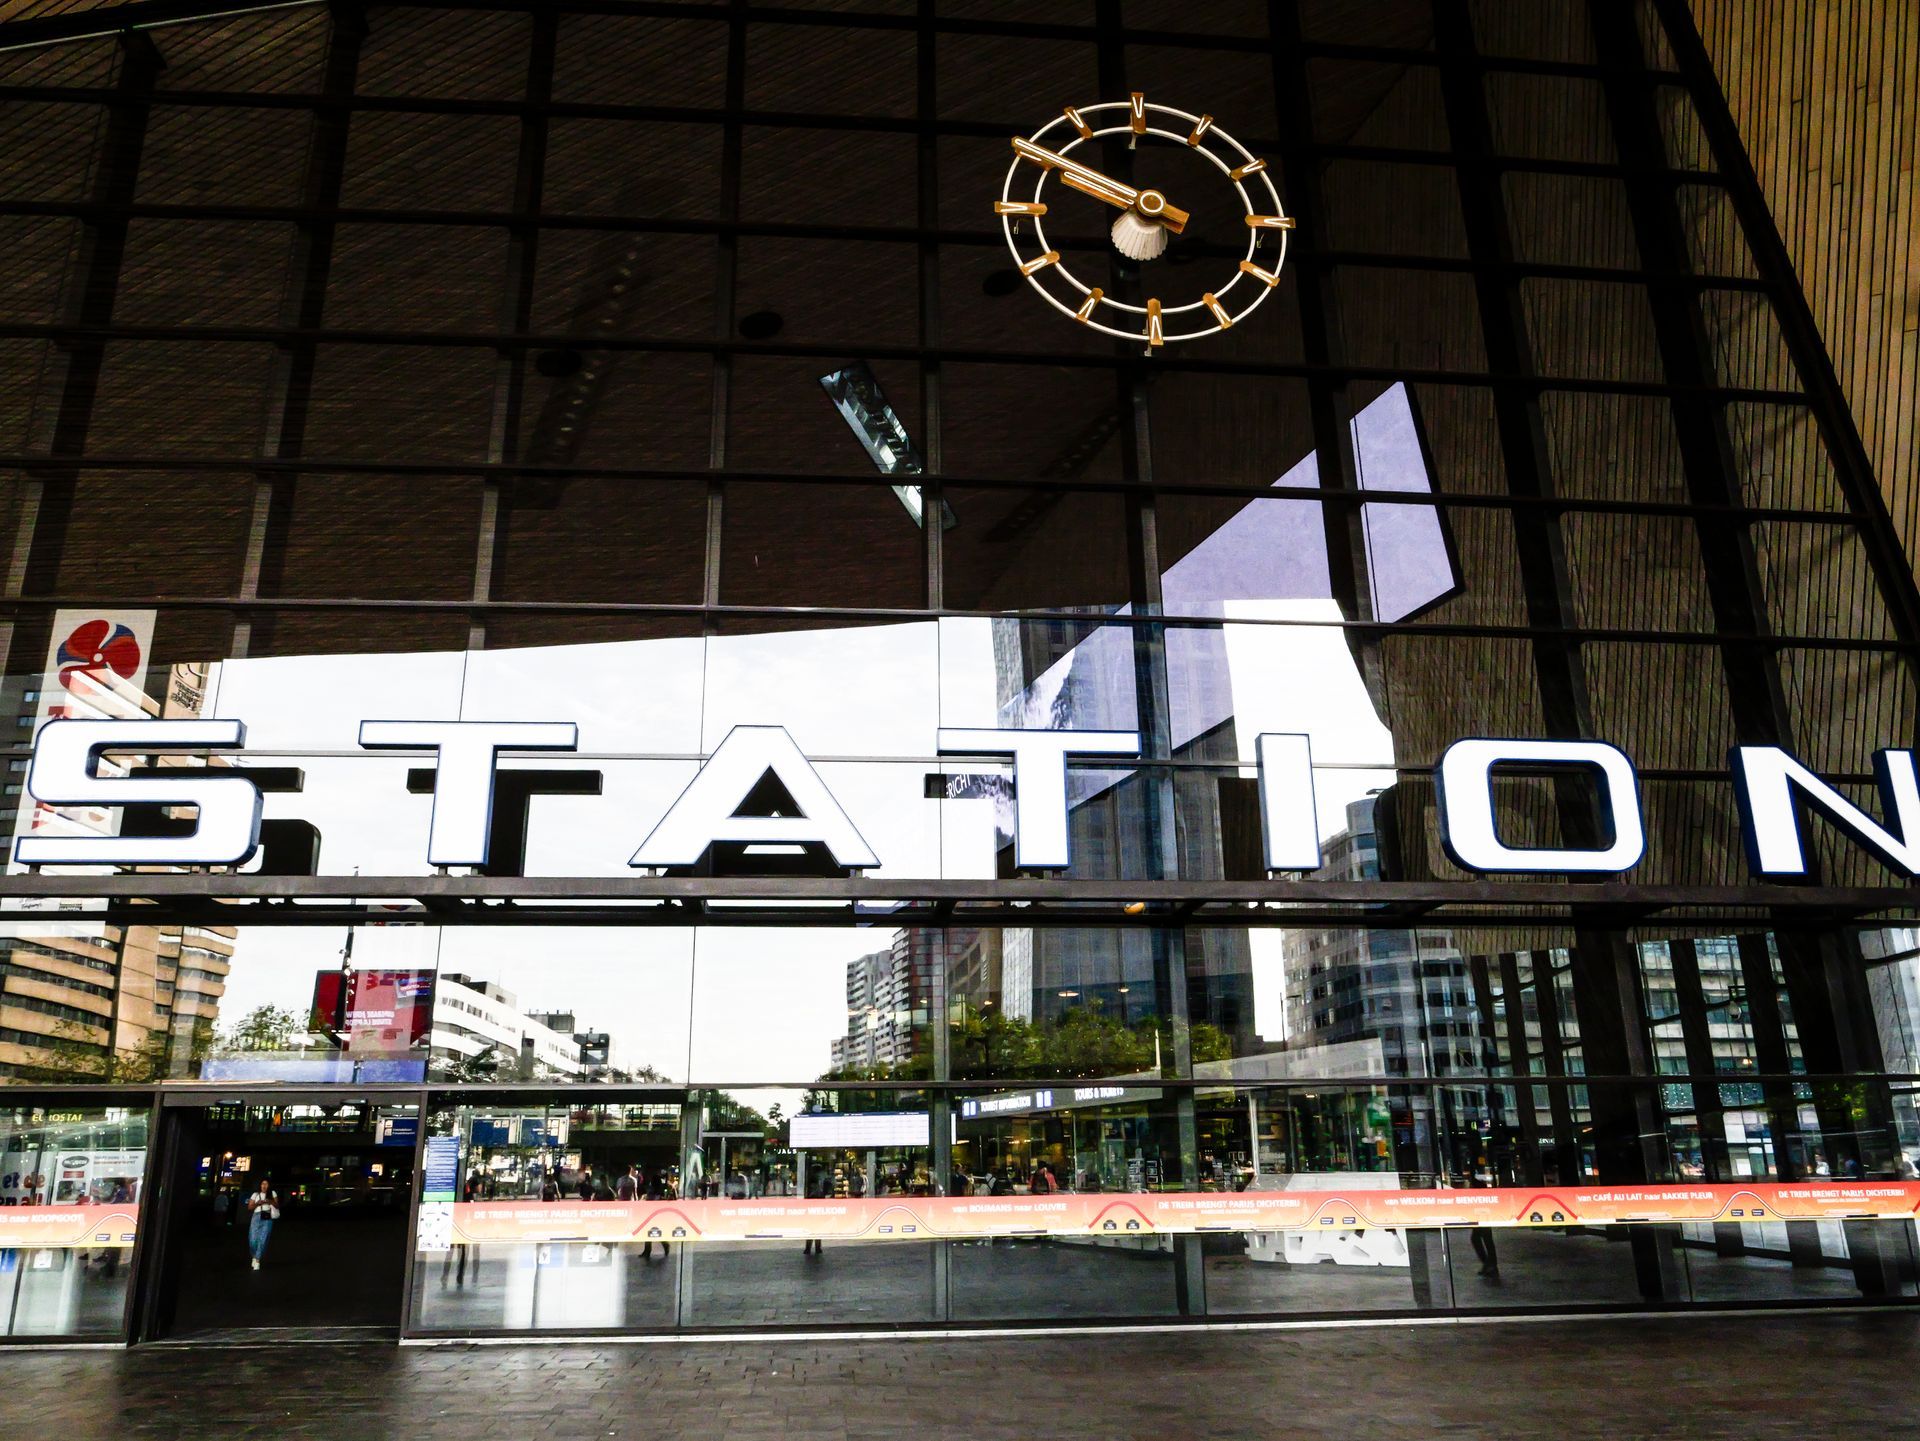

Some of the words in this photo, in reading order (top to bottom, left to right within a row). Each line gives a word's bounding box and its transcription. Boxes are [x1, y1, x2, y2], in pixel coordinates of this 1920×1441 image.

[14, 719, 1920, 876] STATION
[1577, 1194, 1592, 1202] van
[1593, 1192, 1612, 1201] CAFÉ
[1613, 1192, 1625, 1201] AU
[1626, 1192, 1642, 1200] LAIT
[1662, 1192, 1689, 1200] BAKKIE
[1690, 1191, 1713, 1200] PLEUR
[1778, 1190, 1789, 1198] DE
[1789, 1190, 1811, 1198] TREIN
[1811, 1190, 1840, 1198] BRENGT
[1158, 1202, 1170, 1210] DE
[1171, 1201, 1194, 1209] TREIN
[1196, 1201, 1226, 1209] BRENGT
[1385, 1198, 1399, 1206] van
[1400, 1197, 1436, 1205] WELKOM
[1455, 1196, 1499, 1204] BIENVENUE
[807, 1207, 846, 1215] WELKOM
[1034, 1203, 1067, 1211] LOUVRE
[474, 1210, 486, 1219] DE
[488, 1210, 513, 1219] TREIN
[515, 1210, 549, 1218] BRENGT
